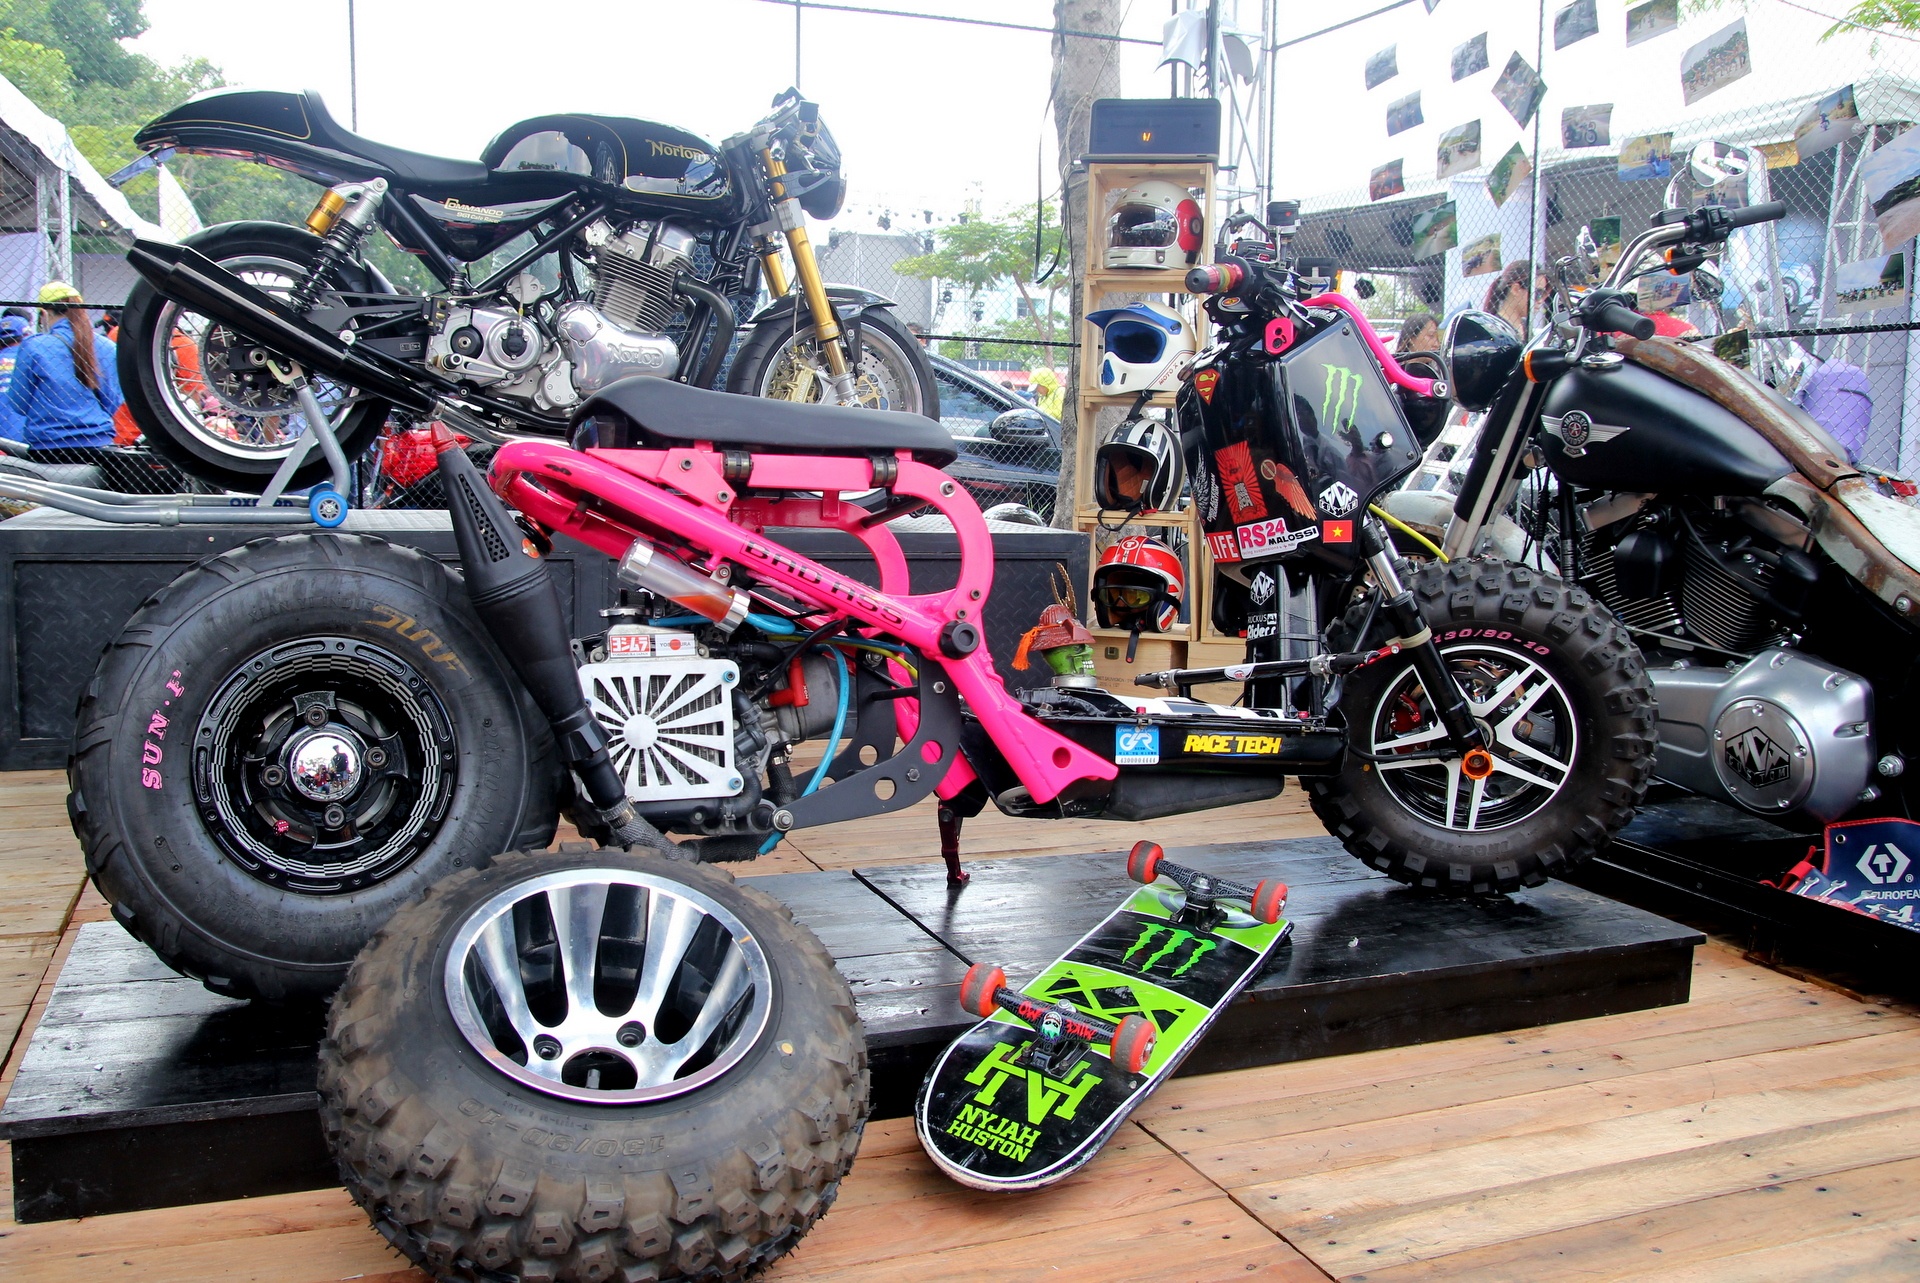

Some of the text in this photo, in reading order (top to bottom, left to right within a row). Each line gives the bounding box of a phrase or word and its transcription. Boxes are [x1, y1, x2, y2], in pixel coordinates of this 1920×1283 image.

[645, 139, 710, 165] Norton
[607, 342, 664, 369] Norton
[1207, 534, 1239, 559] LIFE
[1238, 519, 1286, 549] RS24
[1268, 528, 1317, 546] MALOSSI
[745, 541, 902, 624] BAD ASS
[612, 637, 648, 652] ヨシムラ
[1433, 628, 1550, 655] 130/90-10
[1184, 735, 1282, 754] RACE TECH
[956, 1103, 1041, 1147] NYJAH
[946, 1119, 1031, 1162] HUSTON
